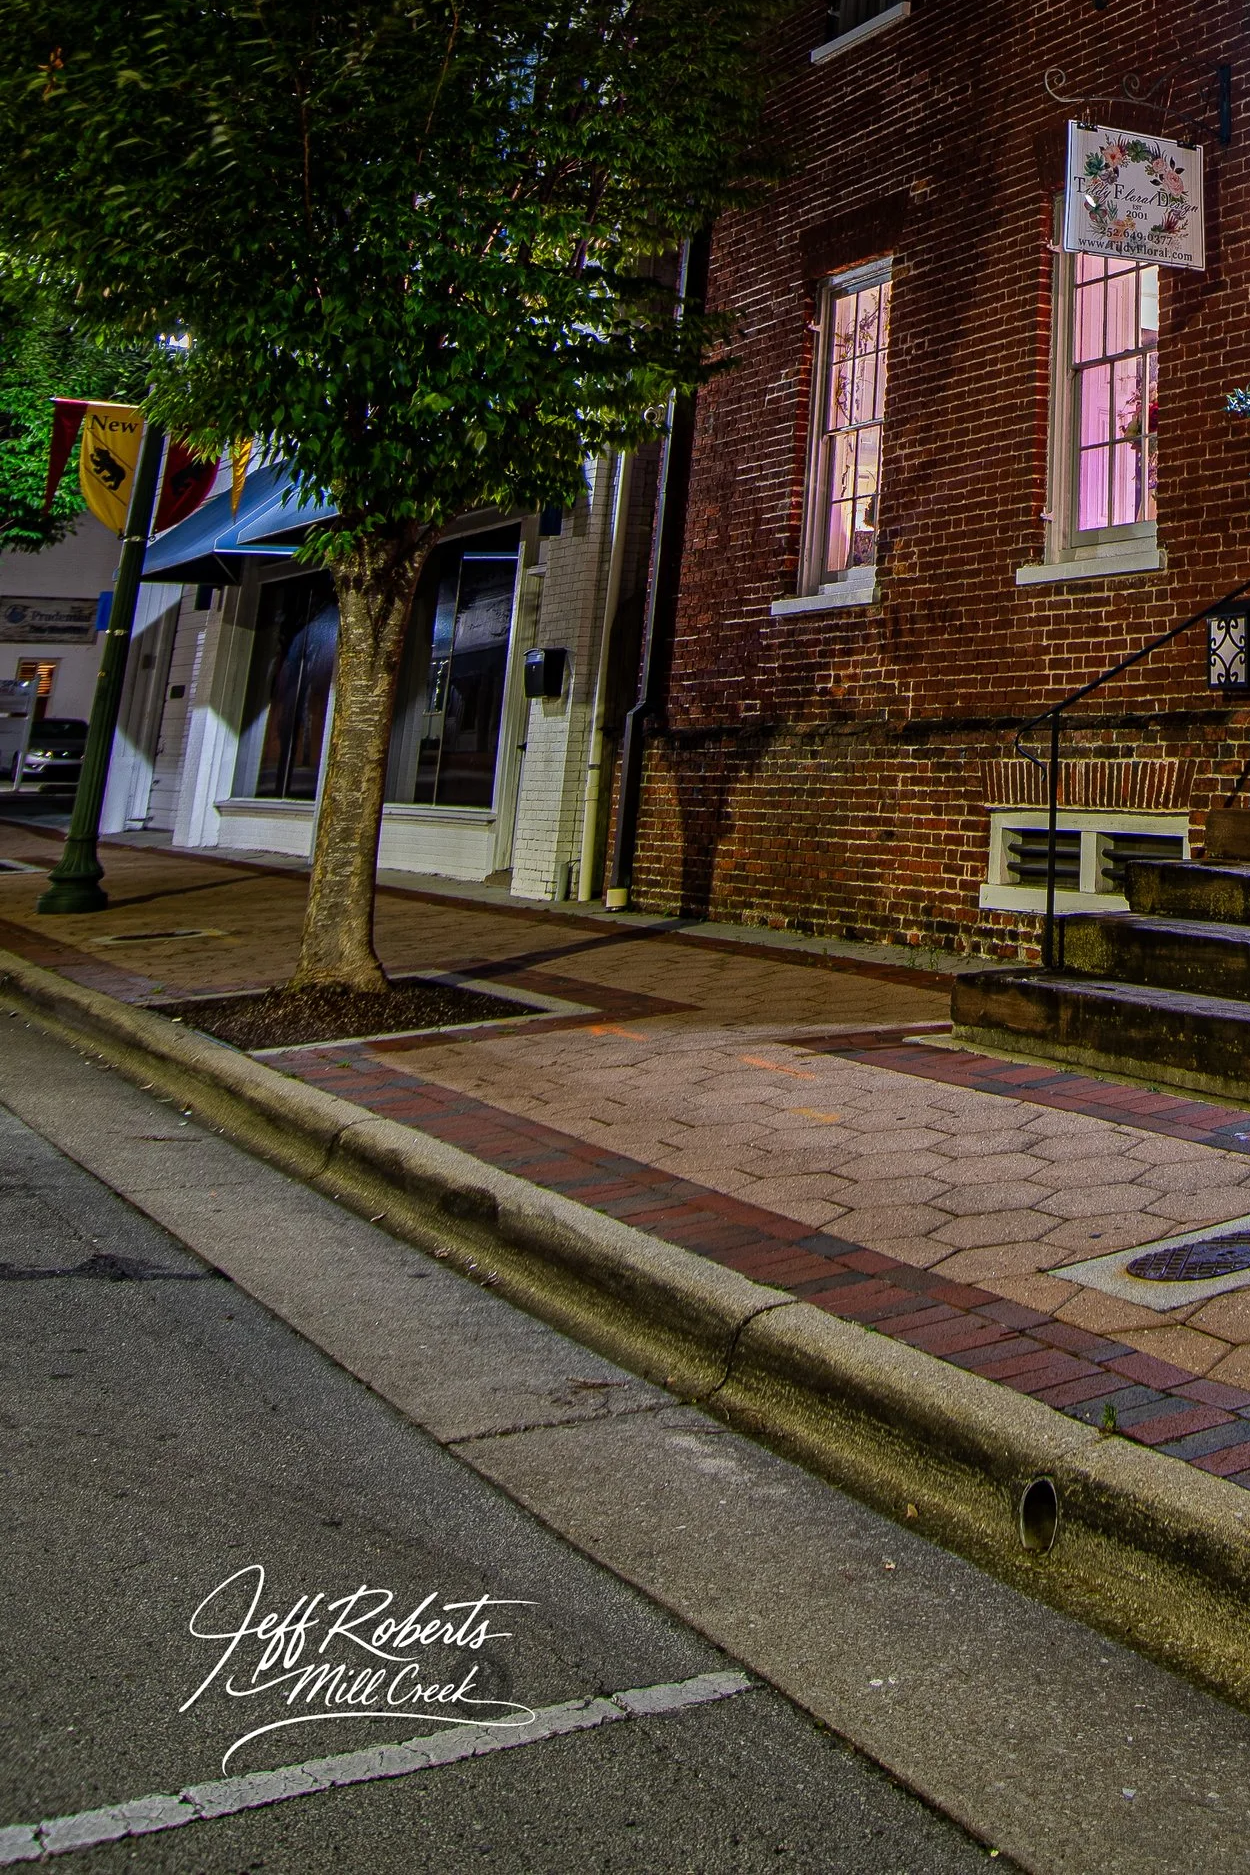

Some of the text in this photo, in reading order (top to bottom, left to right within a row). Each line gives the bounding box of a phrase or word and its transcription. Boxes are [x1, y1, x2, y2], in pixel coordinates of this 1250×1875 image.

[1074, 176, 1199, 216] Tildy Floral Design
[1126, 210, 1148, 220] 2001
[1100, 226, 1173, 245] 252.649.0377
[1078, 237, 1193, 262] www.TildyFloral.com
[91, 414, 139, 434] New
